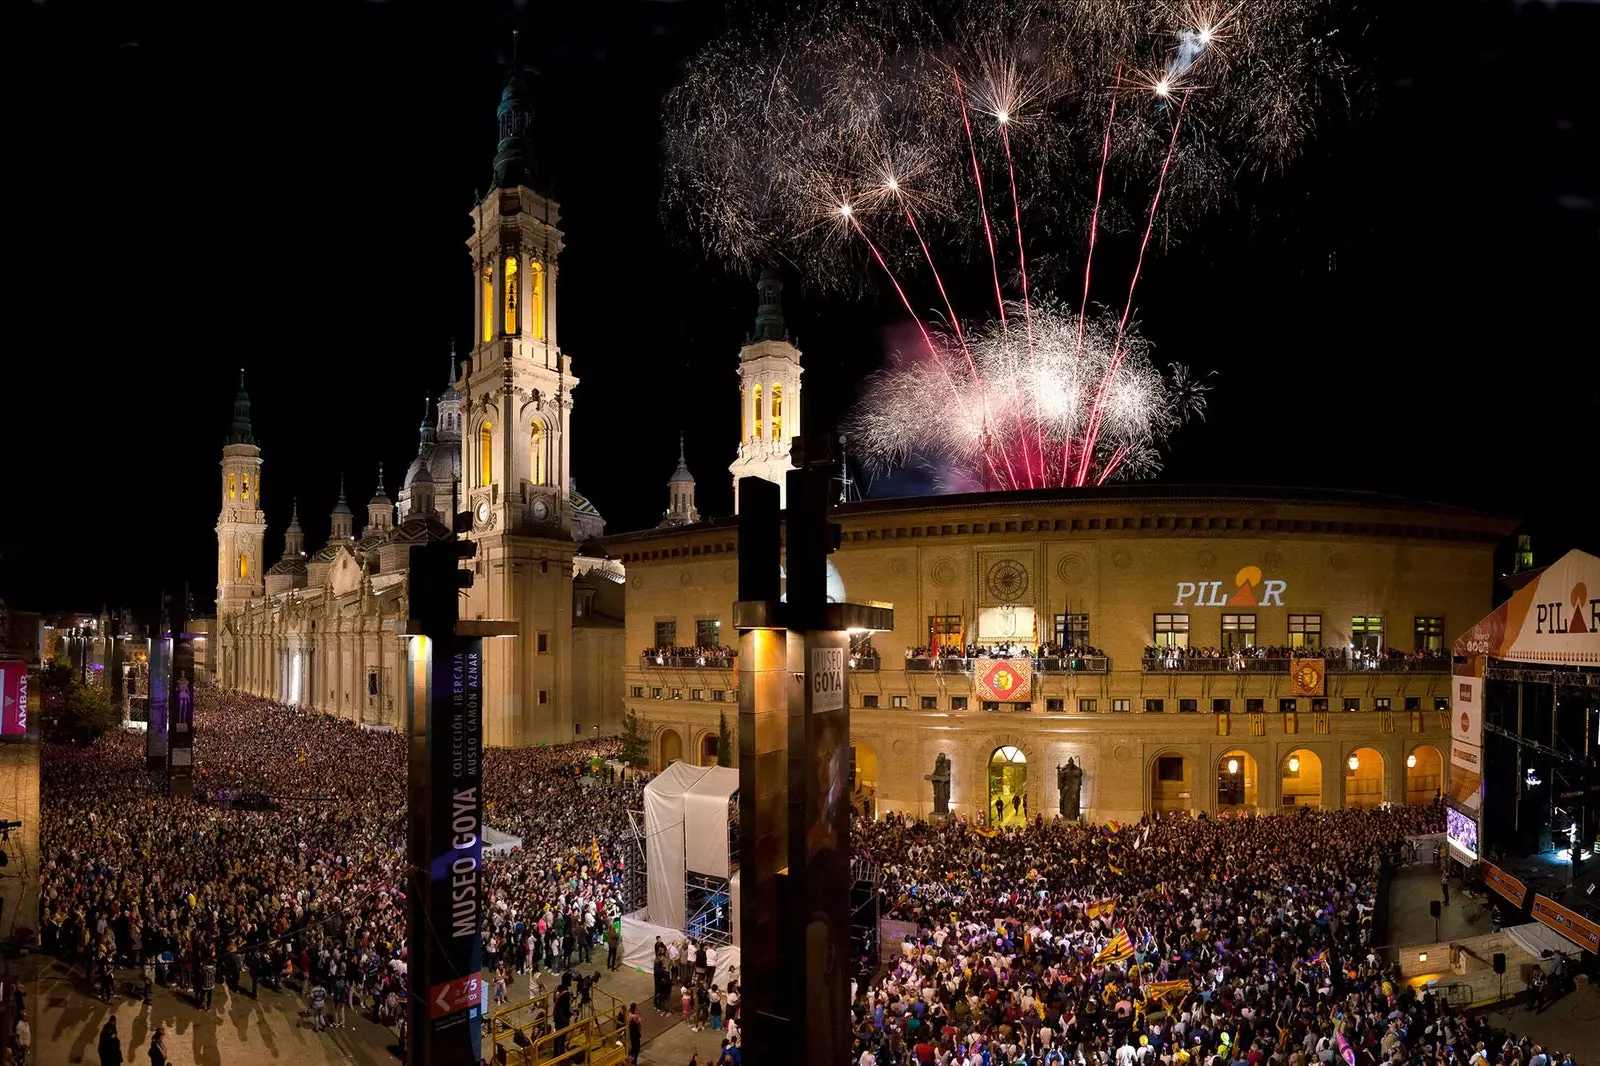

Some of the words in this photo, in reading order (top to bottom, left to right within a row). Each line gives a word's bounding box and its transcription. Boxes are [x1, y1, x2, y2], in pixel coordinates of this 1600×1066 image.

[453, 653, 463, 706] IBERCAJA
[468, 653, 478, 688] AZNAR
[814, 651, 842, 671] MUSEO
[18, 674, 28, 728] AMBAR
[814, 671, 842, 693] GOYA
[467, 738, 477, 776] MUSEO
[452, 786, 477, 850] GOYA
[452, 857, 477, 938] MUSEO
[462, 979, 477, 994] 75
